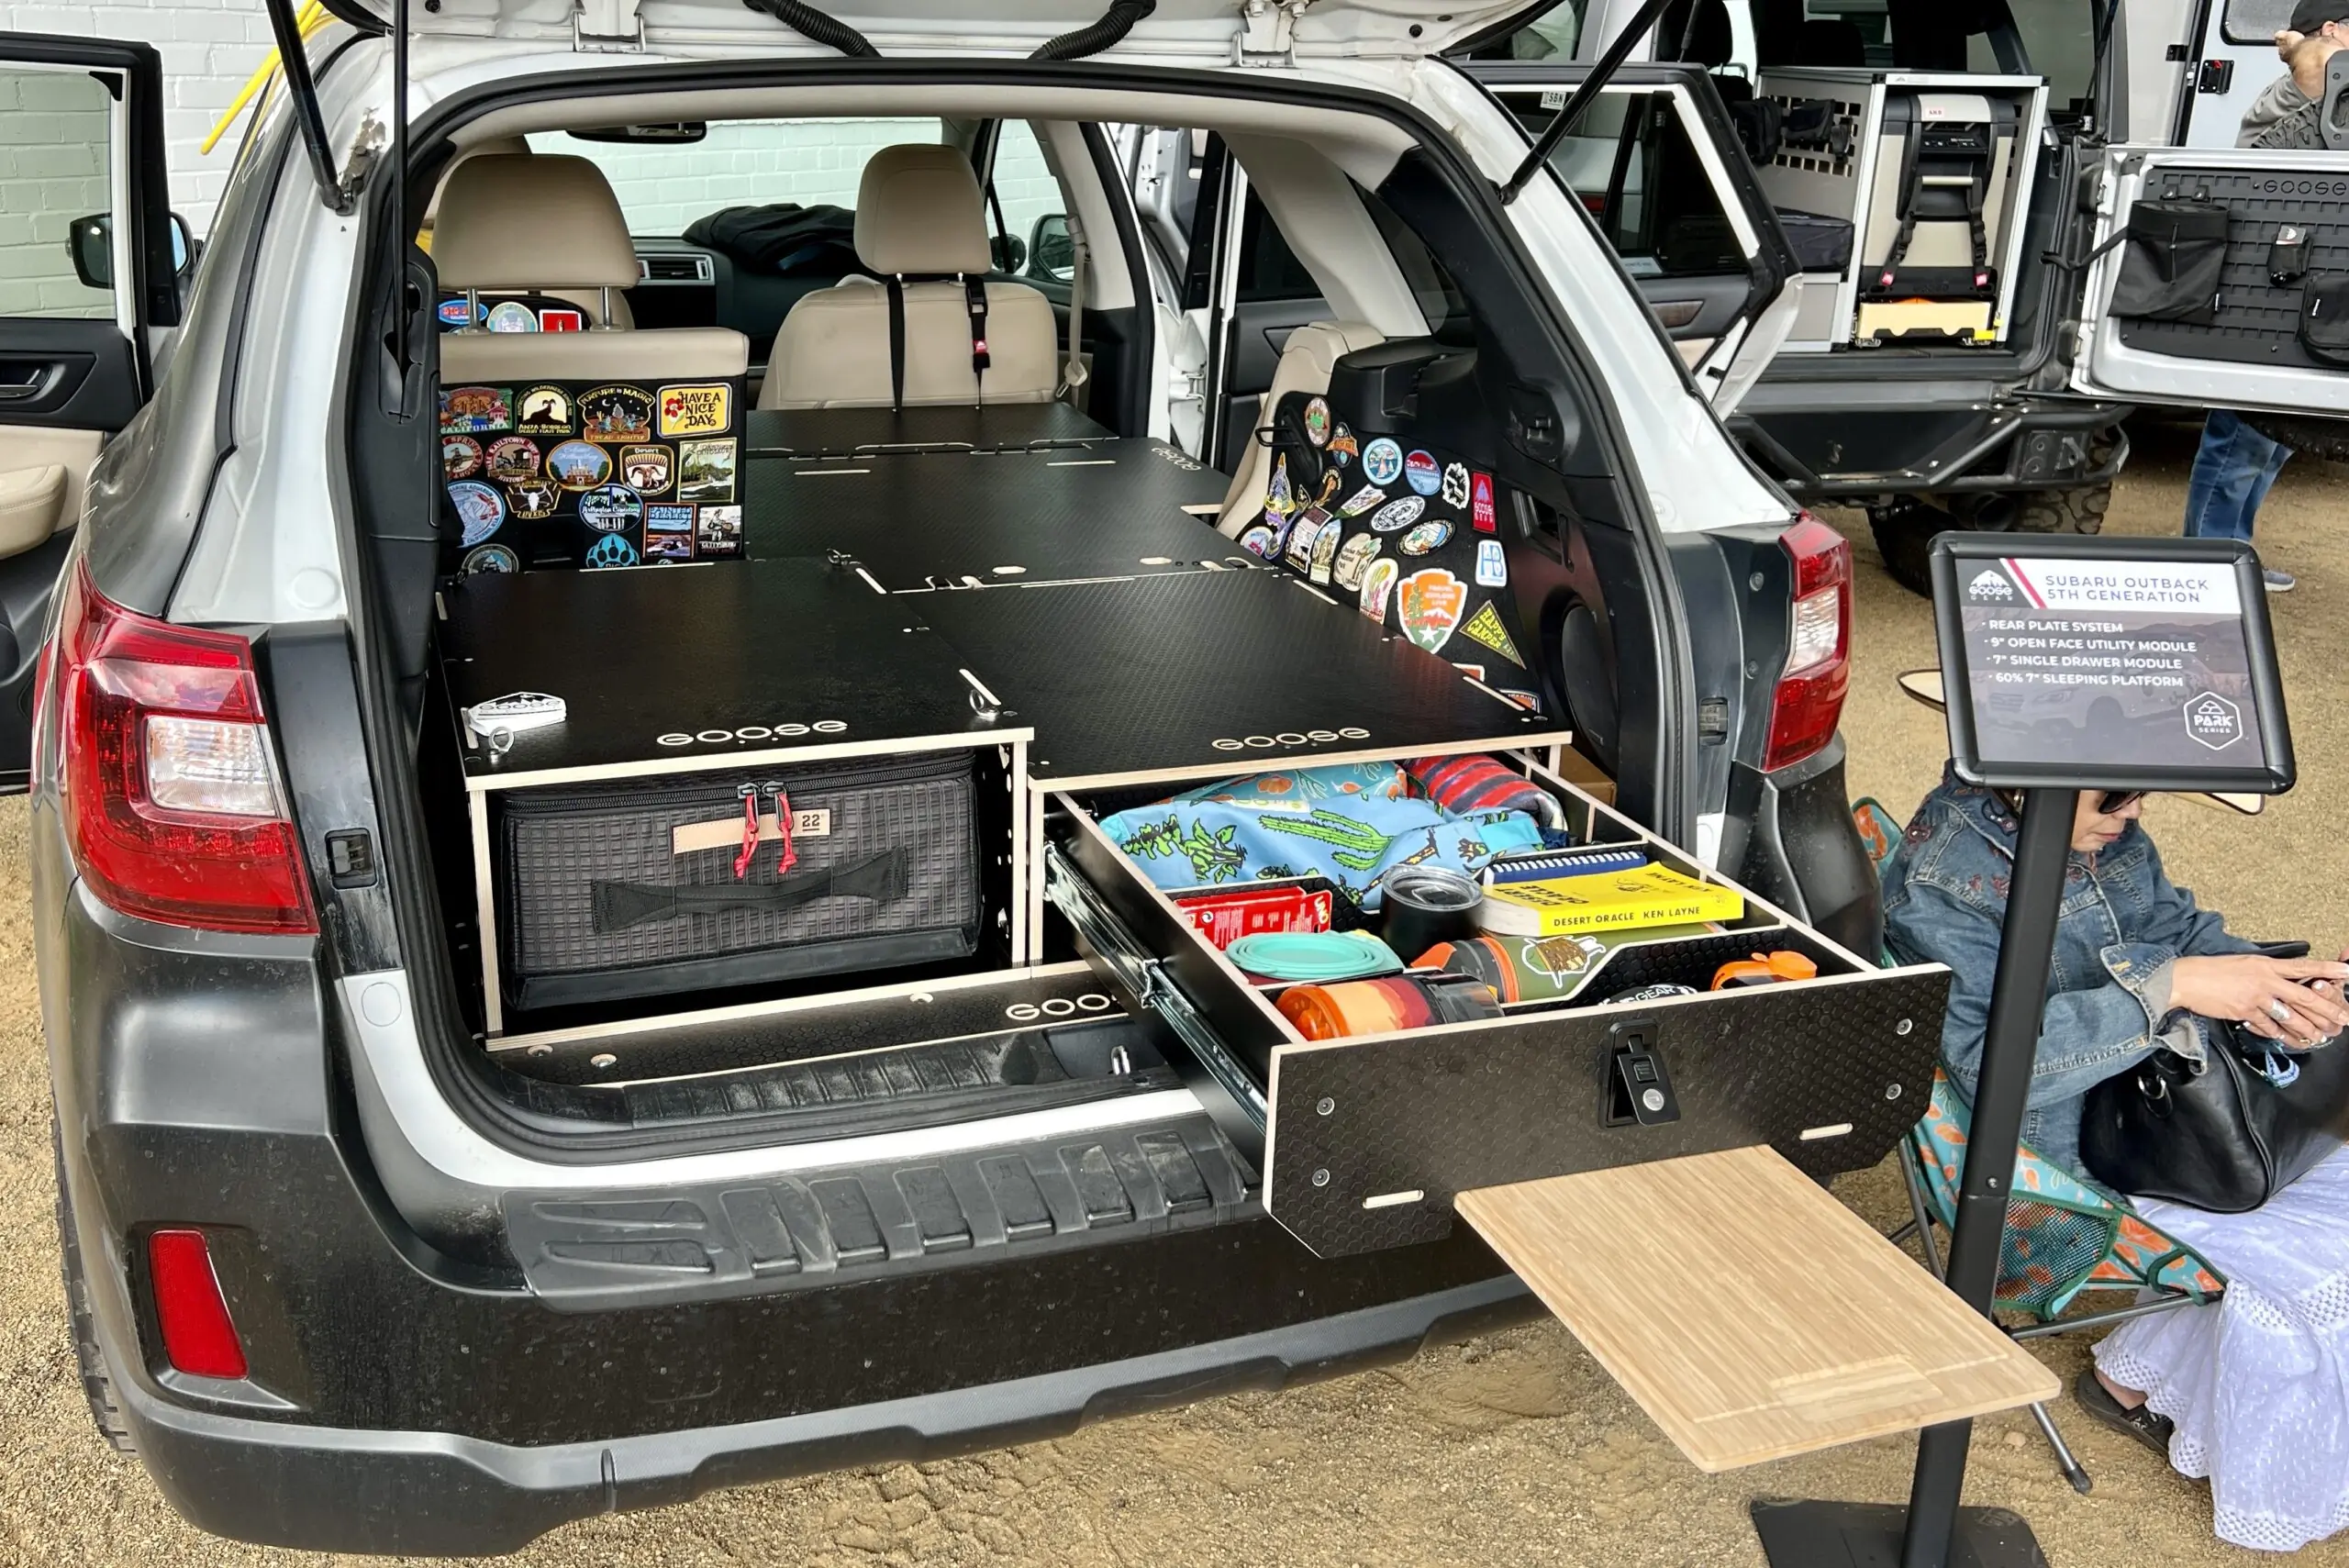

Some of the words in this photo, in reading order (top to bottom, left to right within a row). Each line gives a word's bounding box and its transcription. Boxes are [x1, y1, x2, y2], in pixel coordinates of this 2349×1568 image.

[2263, 179, 2347, 195] GOOSE
[581, 386, 617, 405] NATURE
[623, 387, 652, 405] MAGIC
[678, 391, 711, 404] HAVE
[713, 392, 721, 403] A
[685, 403, 716, 415] NICE
[685, 414, 717, 429] DAY
[2045, 574, 2117, 588] SUBARU
[2124, 576, 2210, 591] OUTBACK
[2047, 588, 2079, 600] 5TH
[2086, 589, 2200, 604] GENERATION
[1479, 607, 1507, 641] HAPPY
[1988, 619, 2026, 631] REAR
[2028, 620, 2070, 632] PLATE
[2072, 621, 2123, 633] SYSTEM
[1466, 619, 1503, 650] CAMPER
[2008, 637, 2046, 649] OPEN
[2049, 638, 2083, 650] FACE
[2087, 639, 2135, 651] UTILITY
[2139, 640, 2197, 652] MODULE
[2010, 654, 2059, 666] SINGLE
[2061, 656, 2121, 668] DRAWER
[2123, 657, 2183, 670] MODULE
[1995, 672, 2024, 684] 60%
[2043, 673, 2109, 685] SLEEPING
[2111, 674, 2184, 687] PLATFORM
[2193, 714, 2235, 727] PARK
[656, 719, 849, 746] GOOSE
[1211, 727, 1371, 751] GOOSE
[801, 814, 821, 828] 22
[1314, 895, 1330, 925] UNO
[1553, 916, 1591, 927] DESERT
[1595, 911, 1635, 923] ORACLE
[1642, 909, 1664, 919] KEN
[1668, 906, 1700, 917] LAYNE
[1635, 986, 1676, 1001] GEAR
[1006, 994, 1118, 1020] GOO
